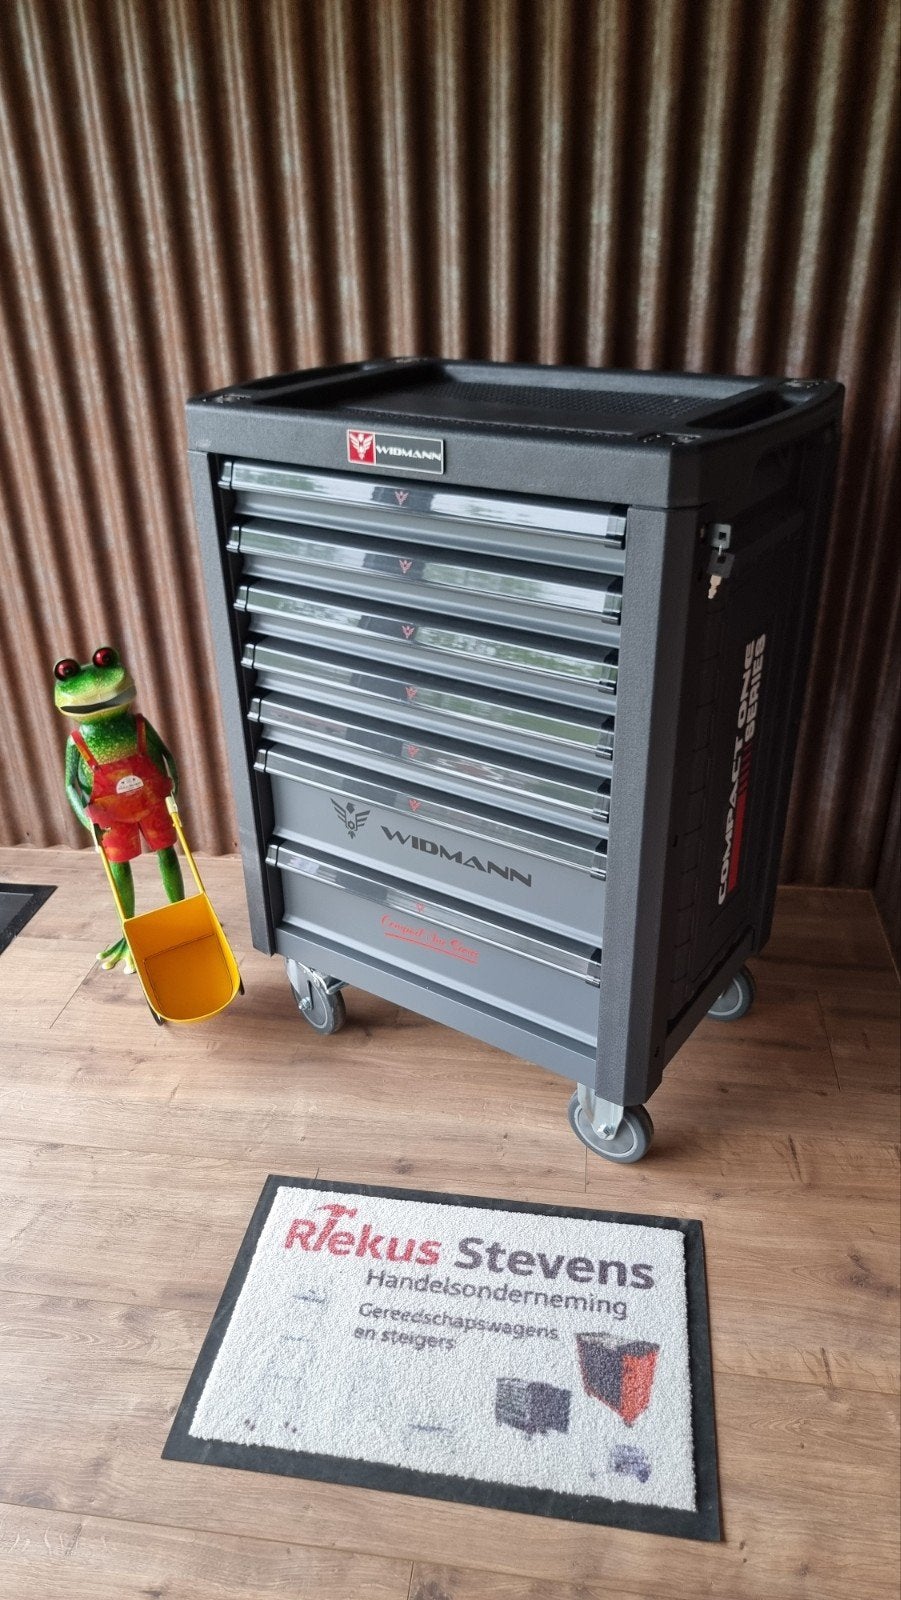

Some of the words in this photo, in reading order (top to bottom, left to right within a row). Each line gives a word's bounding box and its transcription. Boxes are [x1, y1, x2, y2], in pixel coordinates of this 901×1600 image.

[376, 445, 442, 462] WIDMANN
[745, 633, 766, 742] SERIES
[718, 735, 743, 905] COMPACT
[738, 640, 755, 729] ONE
[380, 825, 533, 888] WIDMANN
[454, 1236, 656, 1291] Stevens
[358, 1302, 559, 1341] Gereedschapswagens
[365, 1268, 628, 1321] Handelsonderneming
[354, 1326, 376, 1341] en
[381, 1328, 456, 1351] steigers
